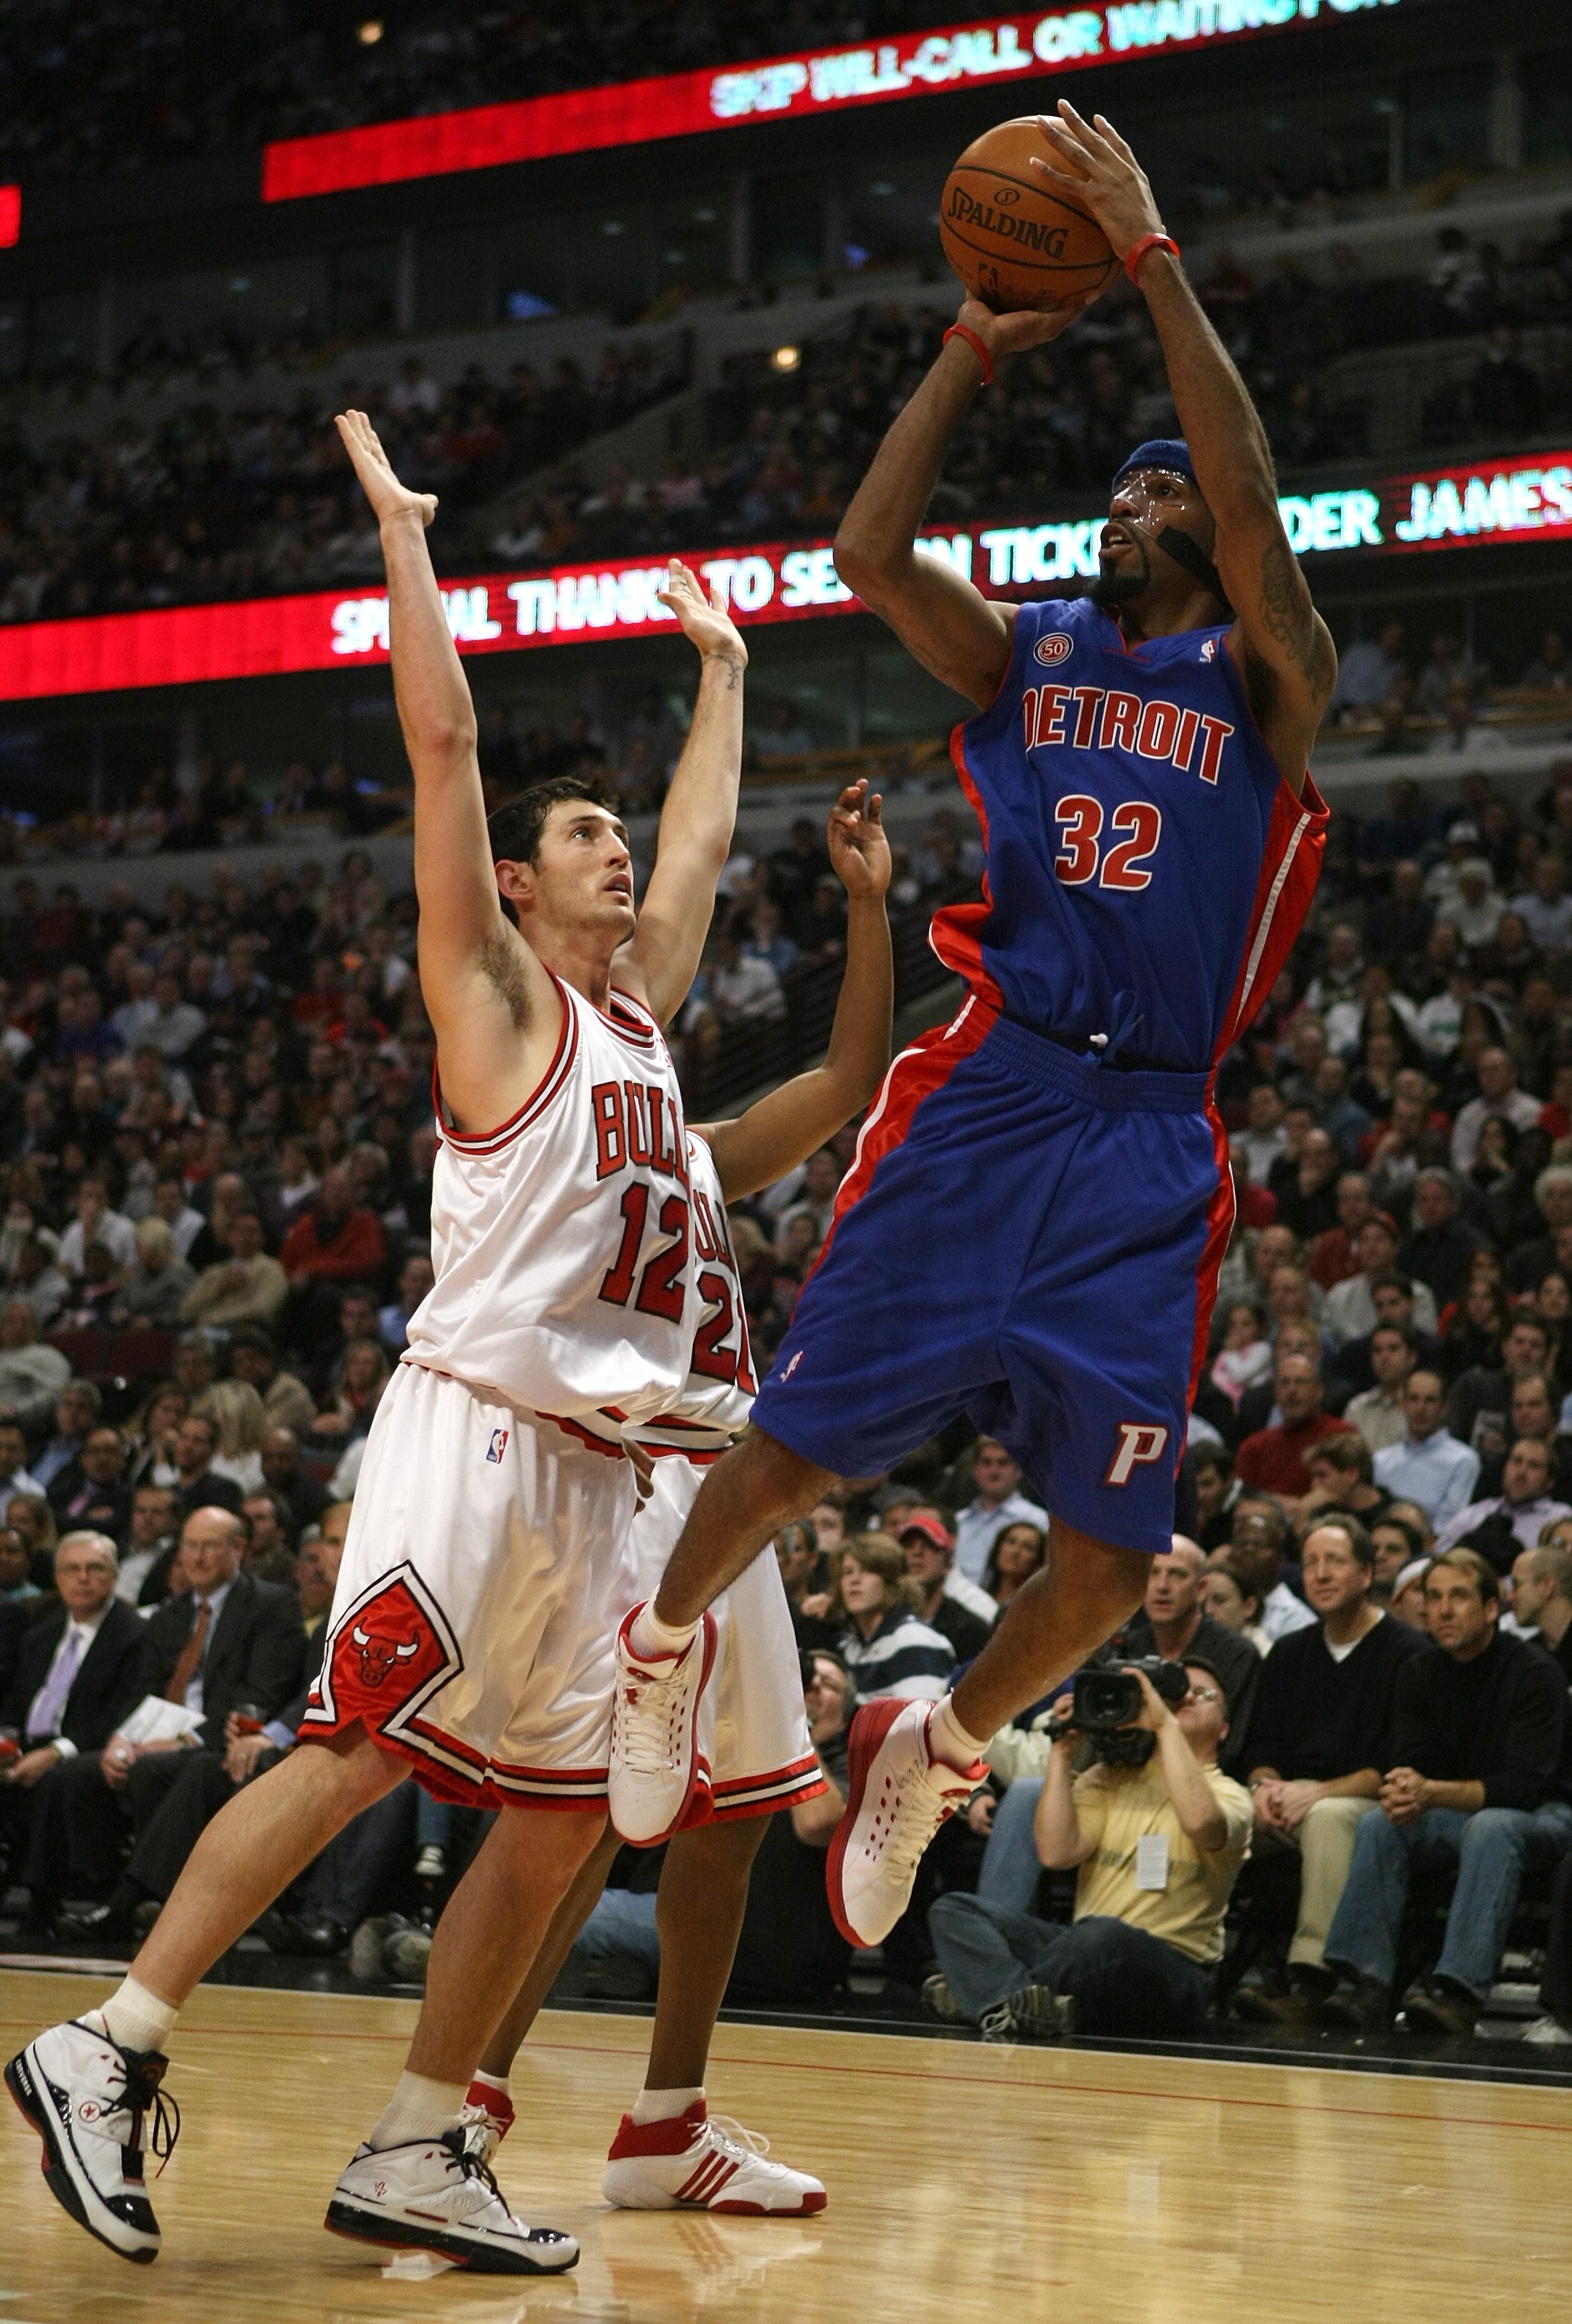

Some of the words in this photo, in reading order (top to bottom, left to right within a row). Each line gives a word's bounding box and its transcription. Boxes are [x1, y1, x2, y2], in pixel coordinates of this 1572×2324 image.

[1033, 10, 1105, 63] OR
[948, 186, 1069, 260] SPALDING
[507, 566, 677, 636] THANK
[700, 555, 775, 612] TO
[1395, 465, 1572, 542] JAMES
[1043, 642, 1063, 656] 50
[1054, 793, 1162, 892] 32
[597, 1180, 690, 1326] 12
[1105, 1419, 1170, 1487] P
